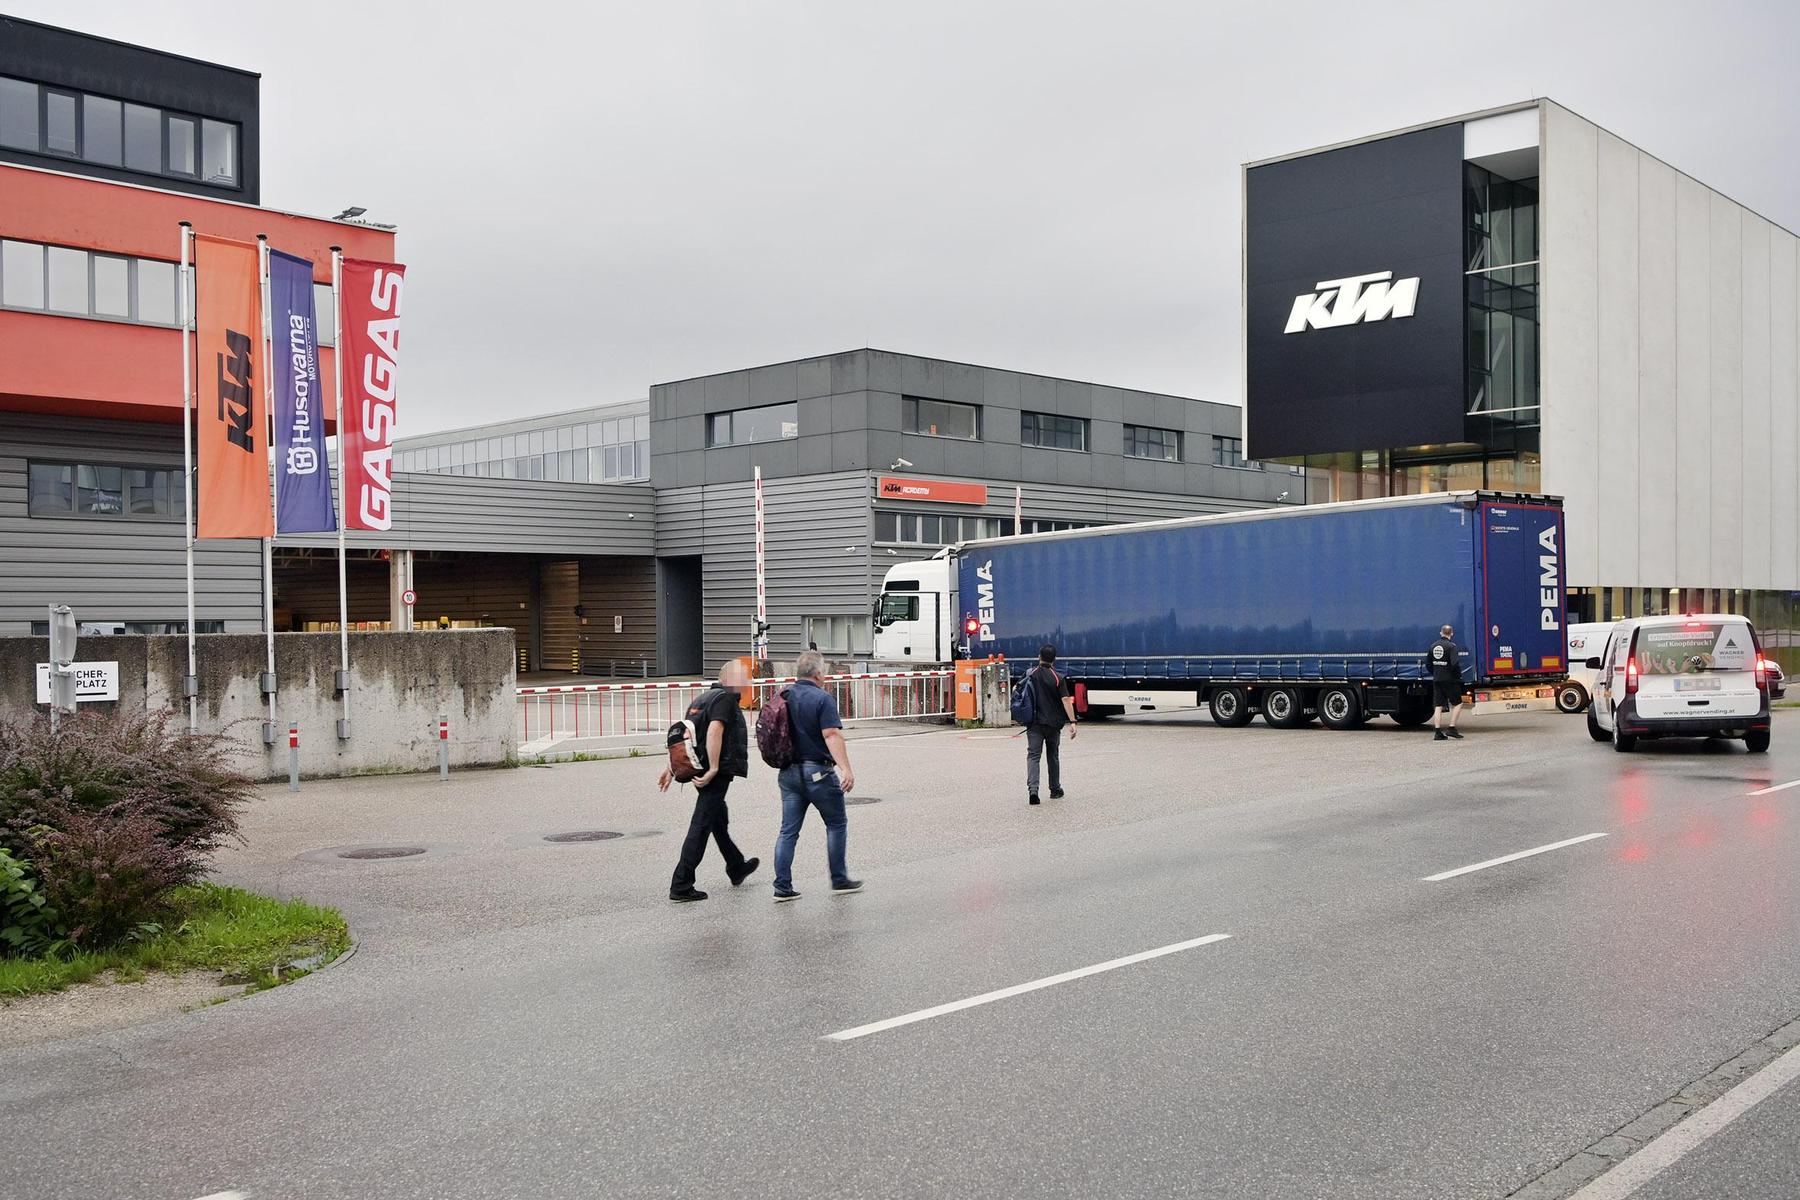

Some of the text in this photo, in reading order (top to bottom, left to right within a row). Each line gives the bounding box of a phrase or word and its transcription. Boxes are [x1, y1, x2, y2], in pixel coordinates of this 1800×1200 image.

[1284, 271, 1420, 334] KTM
[217, 329, 253, 453] KTM
[290, 315, 312, 442] Husqvarna
[360, 268, 404, 531] GASGAS
[977, 559, 996, 641] PEMA
[1539, 525, 1559, 630] PEMA
